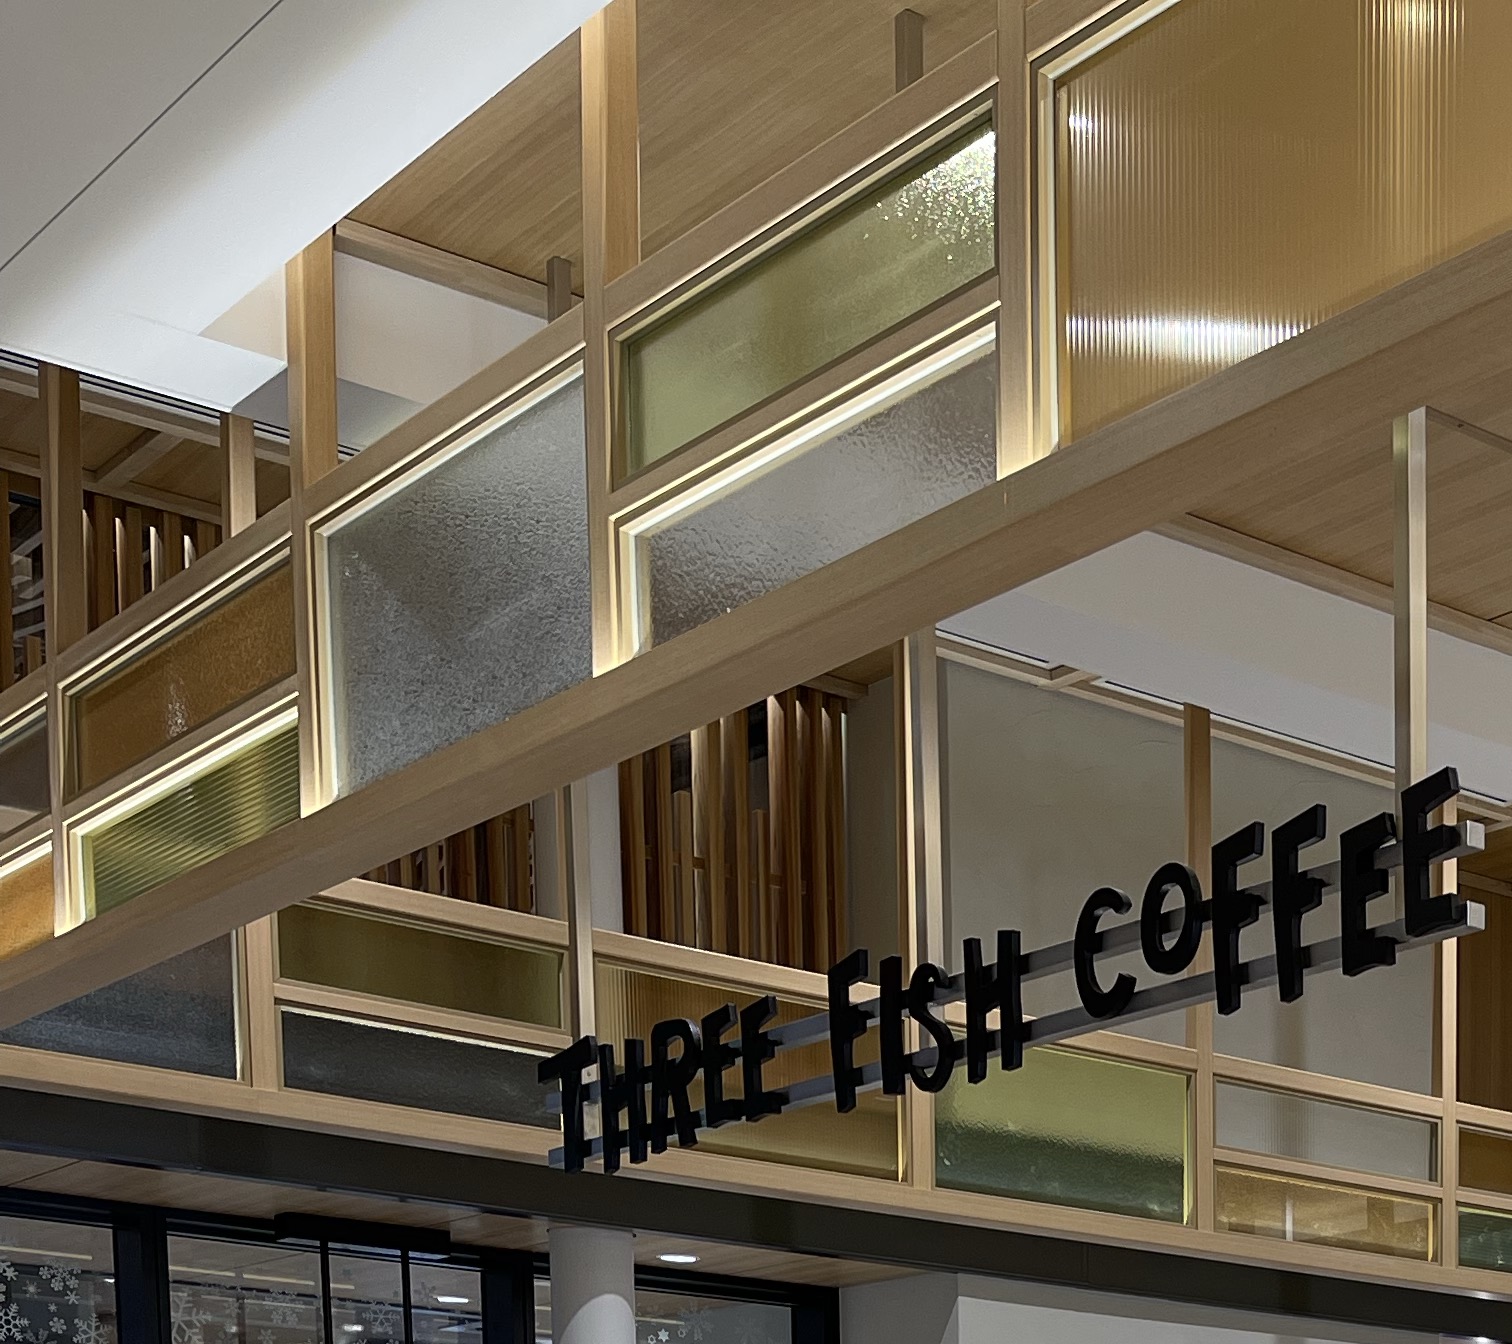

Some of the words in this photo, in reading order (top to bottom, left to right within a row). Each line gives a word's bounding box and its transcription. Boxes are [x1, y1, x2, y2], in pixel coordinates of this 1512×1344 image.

[537, 995, 783, 1175] THREE
[826, 928, 1024, 1114] FISH
[1073, 765, 1467, 1021] COFFEE
